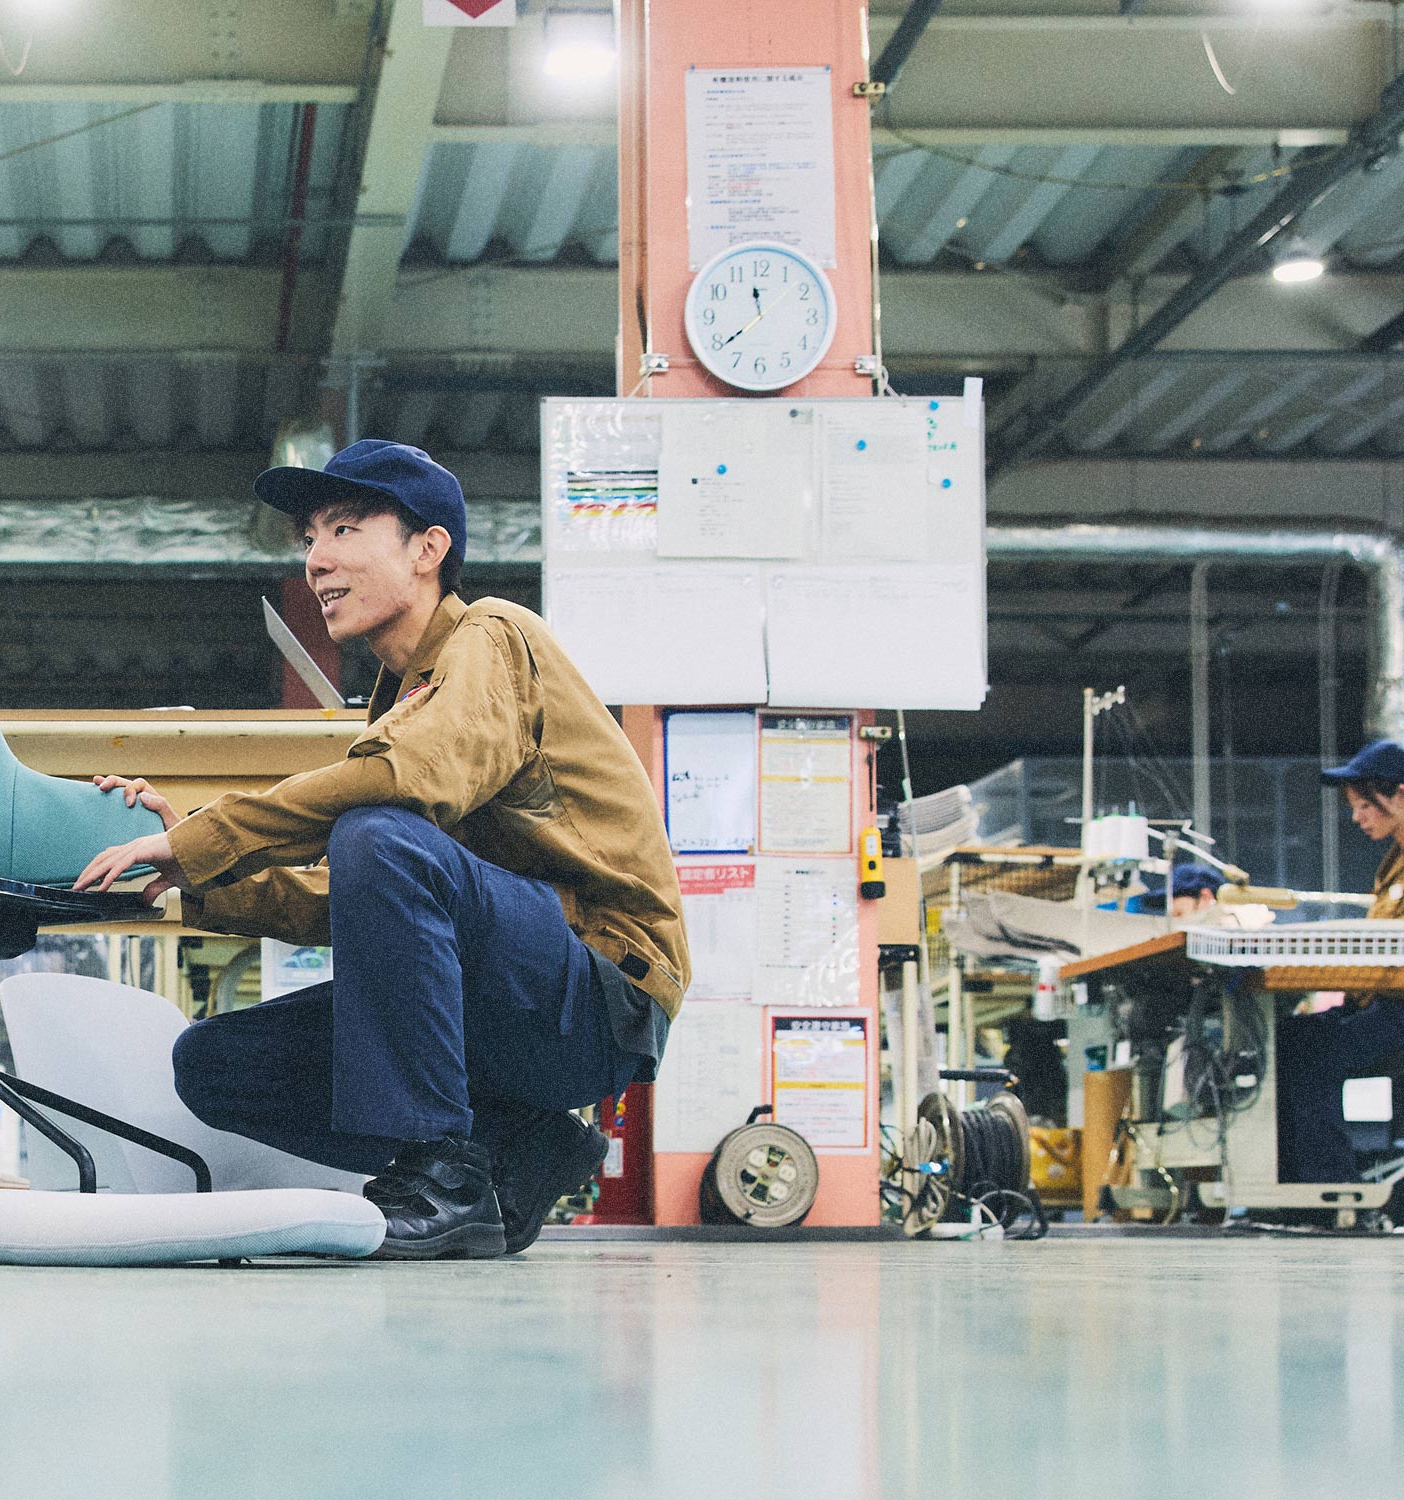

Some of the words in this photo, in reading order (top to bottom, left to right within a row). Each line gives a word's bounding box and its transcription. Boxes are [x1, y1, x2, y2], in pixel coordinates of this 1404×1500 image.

[730, 266, 743, 283] 11
[753, 259, 770, 277] 12
[710, 283, 727, 301] 10
[799, 283, 810, 301] 2
[703, 308, 715, 326] 9
[806, 308, 818, 326] 3
[711, 333, 724, 351] 8
[798, 334, 807, 350] 4
[732, 351, 743, 368] 7
[754, 356, 766, 374] 6
[780, 351, 791, 368] 5
